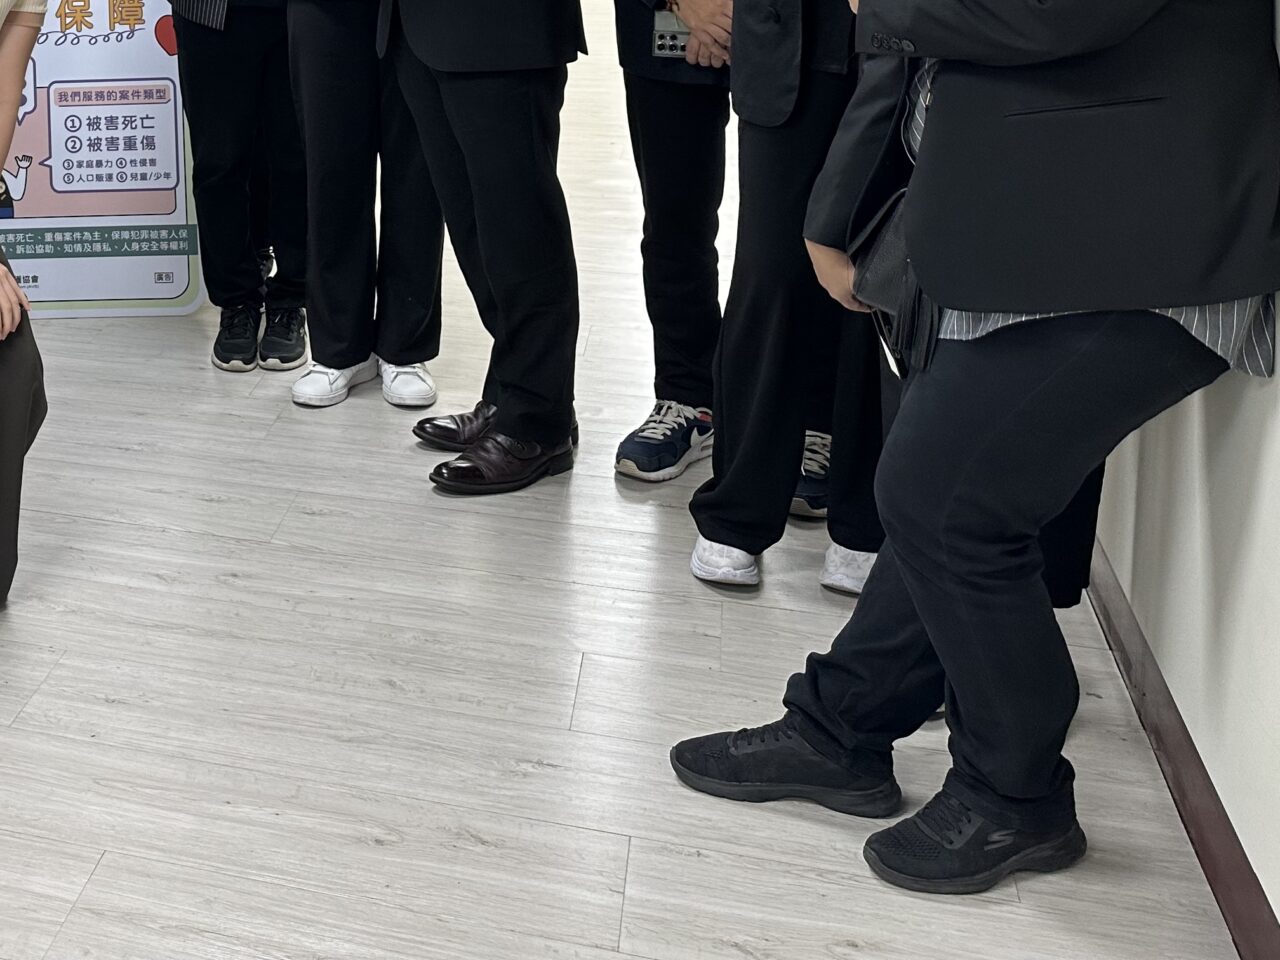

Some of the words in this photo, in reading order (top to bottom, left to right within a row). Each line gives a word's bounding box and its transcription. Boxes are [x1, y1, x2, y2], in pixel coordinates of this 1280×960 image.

[57, 87, 167, 103] 我們服務的案件類型
[86, 114, 156, 131] 被害死亡
[86, 135, 157, 153] 被害重傷
